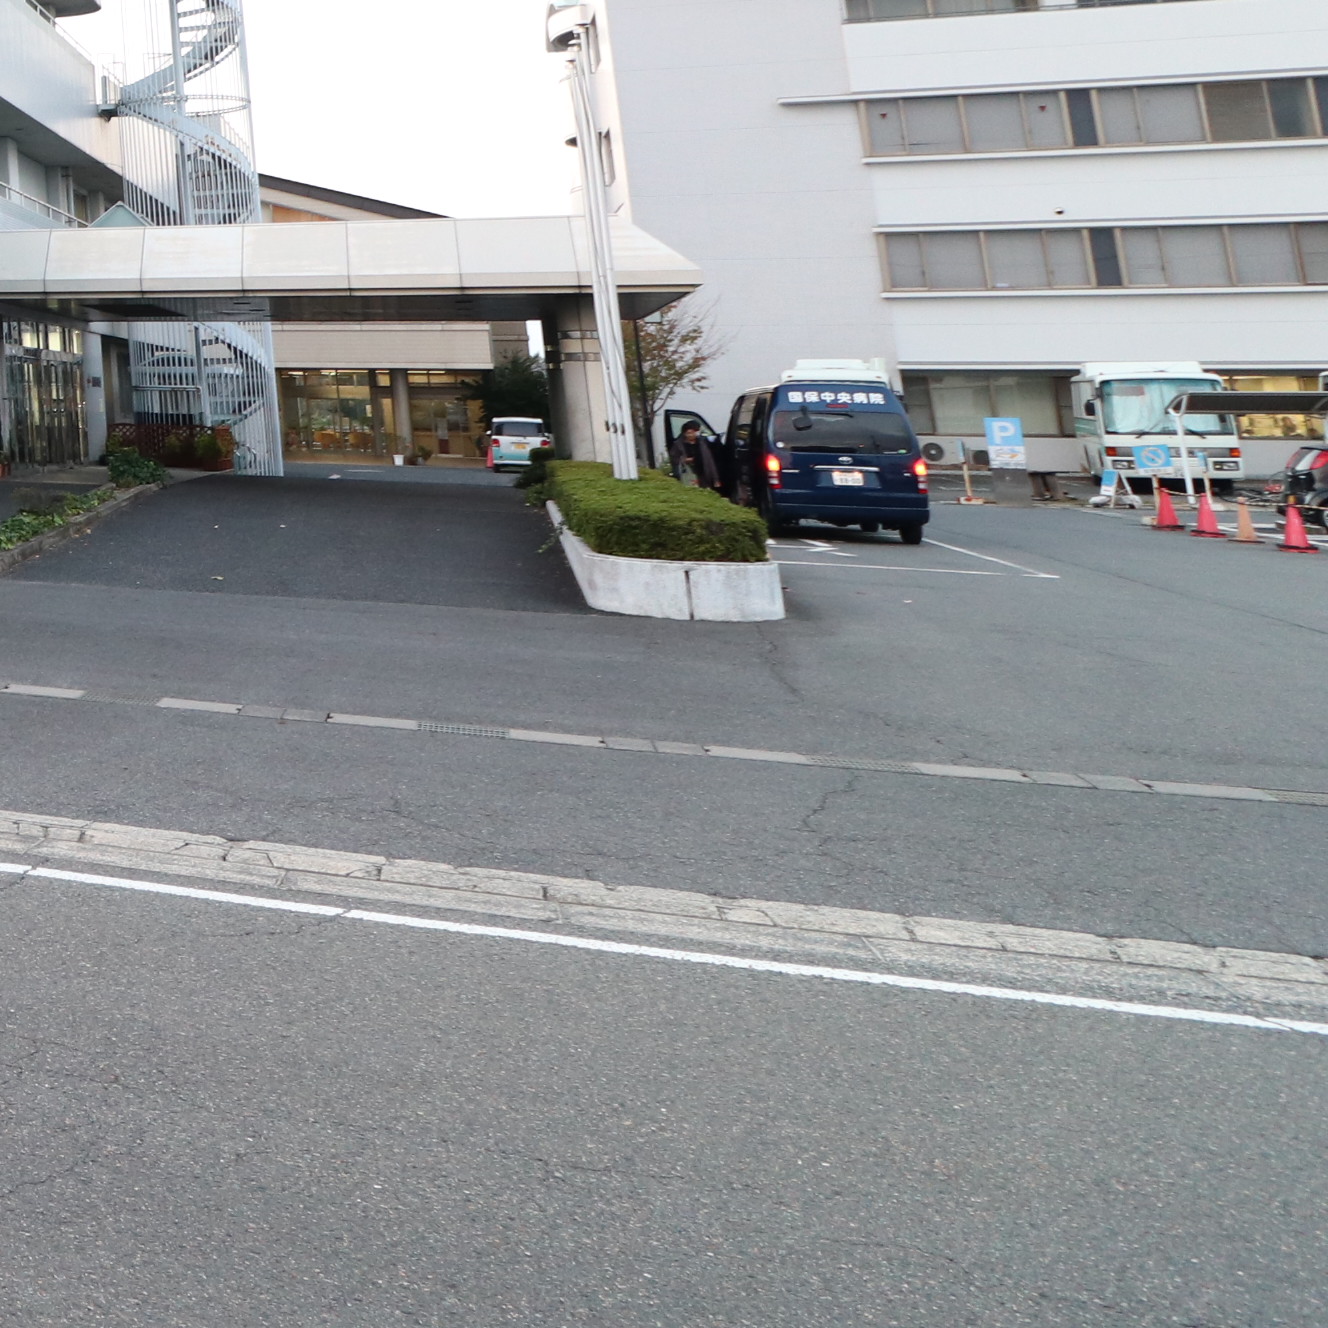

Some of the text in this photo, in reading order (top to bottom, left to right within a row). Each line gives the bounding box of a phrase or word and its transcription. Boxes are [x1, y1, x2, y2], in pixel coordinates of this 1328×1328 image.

[787, 391, 886, 405] 国保中央病院
[991, 421, 1016, 445] P
